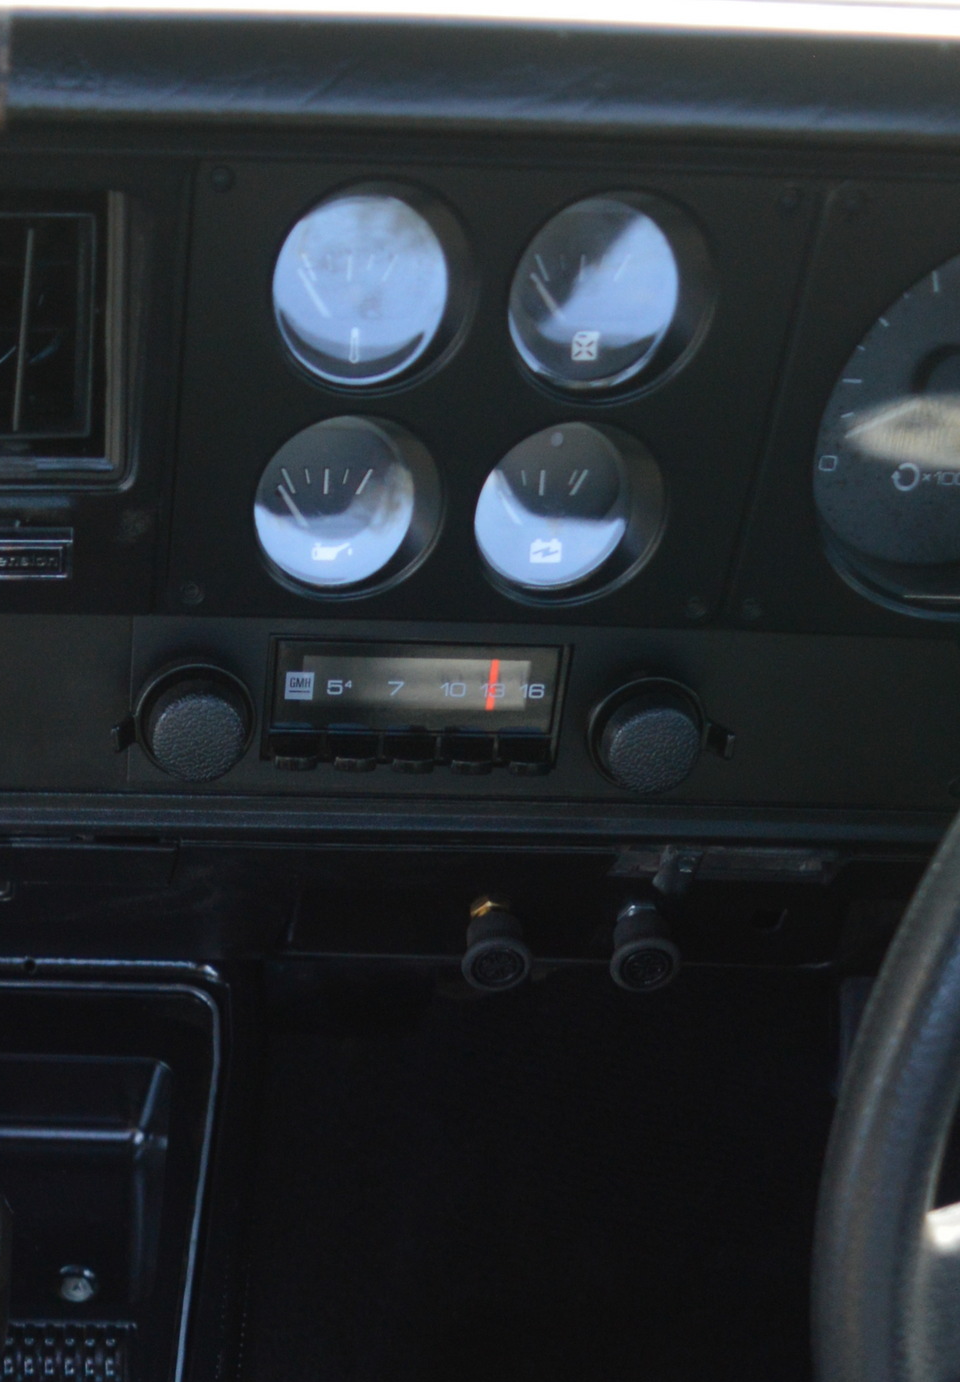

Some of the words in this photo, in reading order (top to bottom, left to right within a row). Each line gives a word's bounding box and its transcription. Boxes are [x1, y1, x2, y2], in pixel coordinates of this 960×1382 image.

[289, 677, 312, 689] GMH
[387, 681, 405, 696] 7
[440, 682, 467, 698] 10
[519, 683, 546, 699] 16
